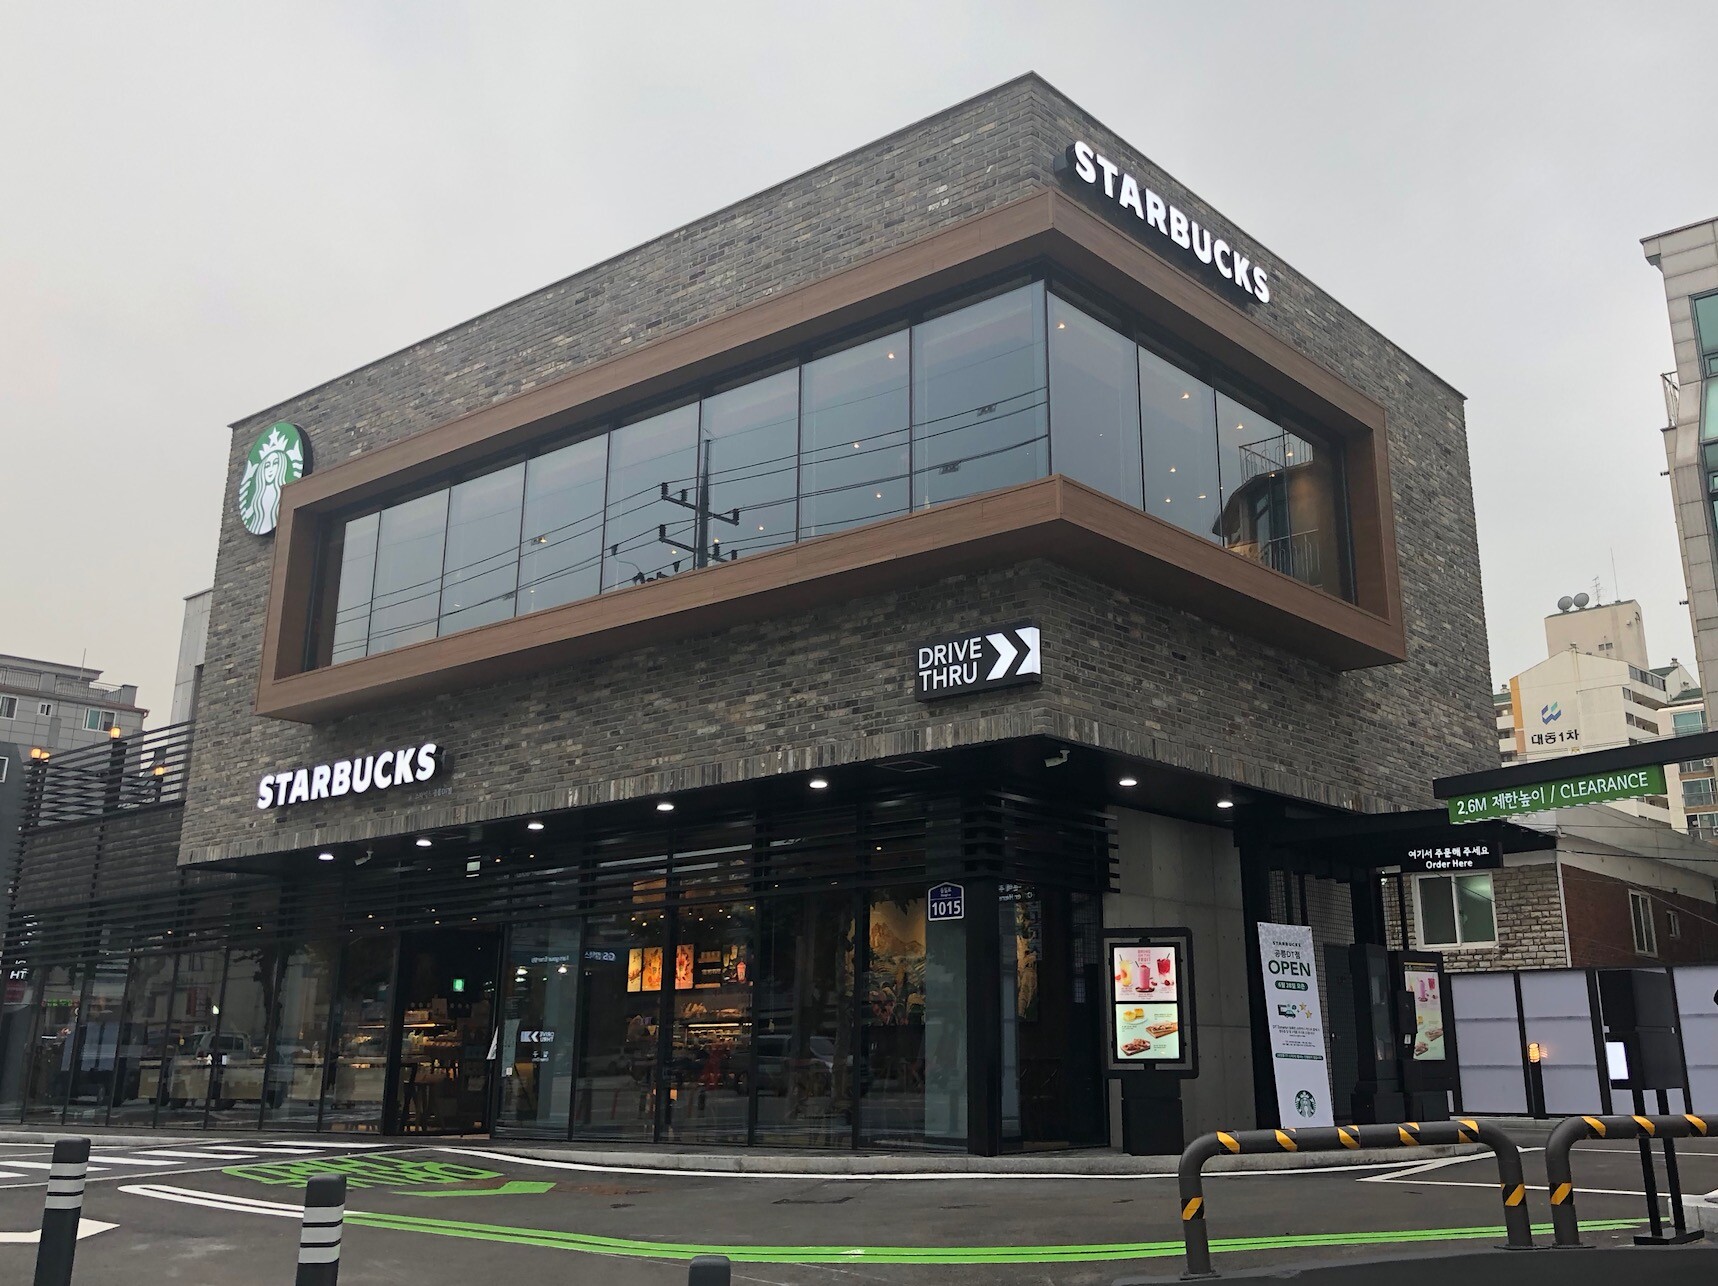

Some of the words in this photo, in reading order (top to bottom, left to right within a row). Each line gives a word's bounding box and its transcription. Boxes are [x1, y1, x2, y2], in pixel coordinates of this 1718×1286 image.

[1074, 140, 1270, 304] STARBUCKS
[918, 636, 983, 669] DRIVE
[918, 661, 979, 692] THRU
[1531, 729, 1580, 745] 대동1차
[256, 743, 437, 810] STARBUCKS
[1457, 797, 1487, 815] 2.6M
[1492, 786, 1545, 811] 제한높이
[1550, 785, 1556, 803] /
[1560, 771, 1649, 799] CLEARANCE
[1408, 848, 1433, 859] 여기서
[1434, 846, 1461, 858] 주문해
[1462, 845, 1490, 857] 주세요
[1425, 860, 1451, 869] Order
[1452, 859, 1473, 868] Here
[932, 900, 961, 916] 1015
[1268, 960, 1311, 977] OPEN
